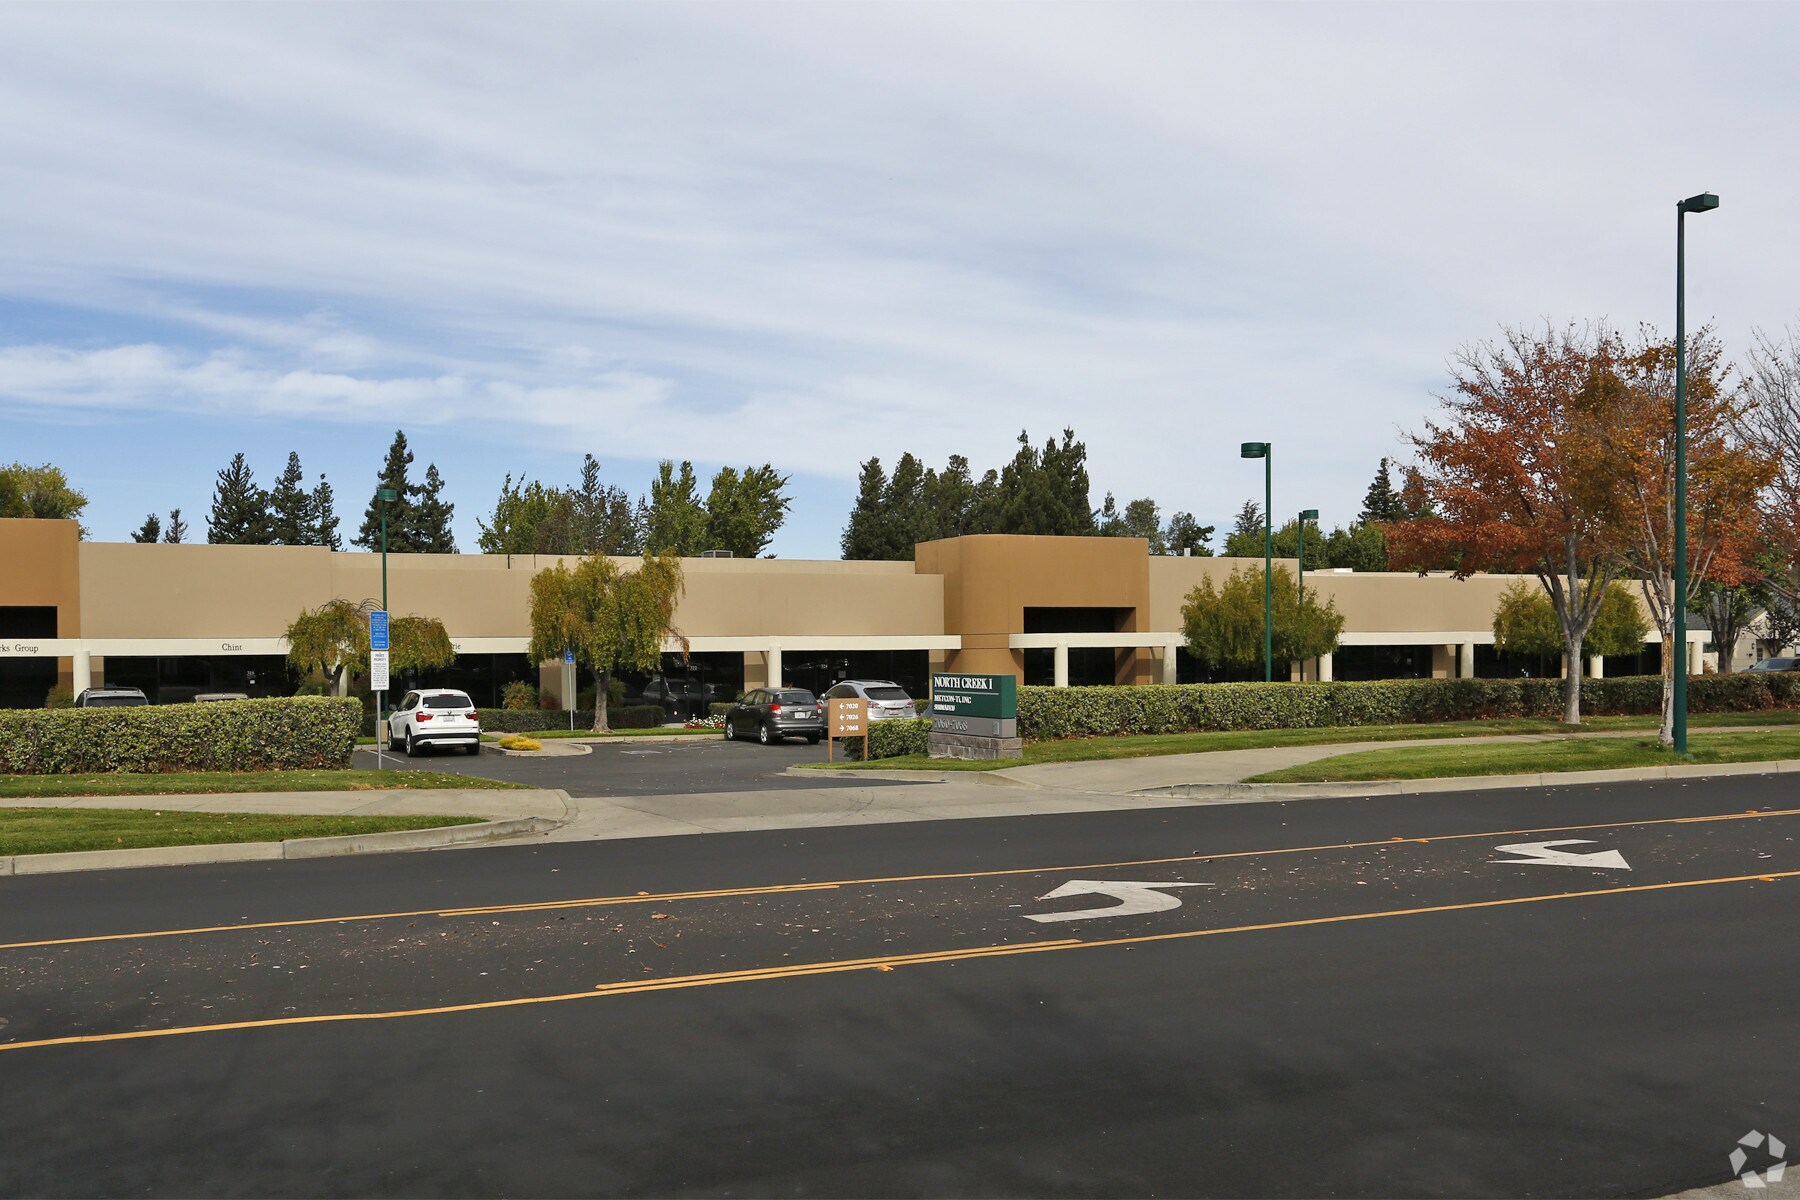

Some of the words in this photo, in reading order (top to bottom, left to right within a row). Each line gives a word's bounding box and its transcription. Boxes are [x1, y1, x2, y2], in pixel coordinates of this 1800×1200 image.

[15, 644, 39, 654] Group
[221, 643, 242, 651] Chint
[934, 677, 960, 688] NORTH
[961, 678, 988, 689] CREEK
